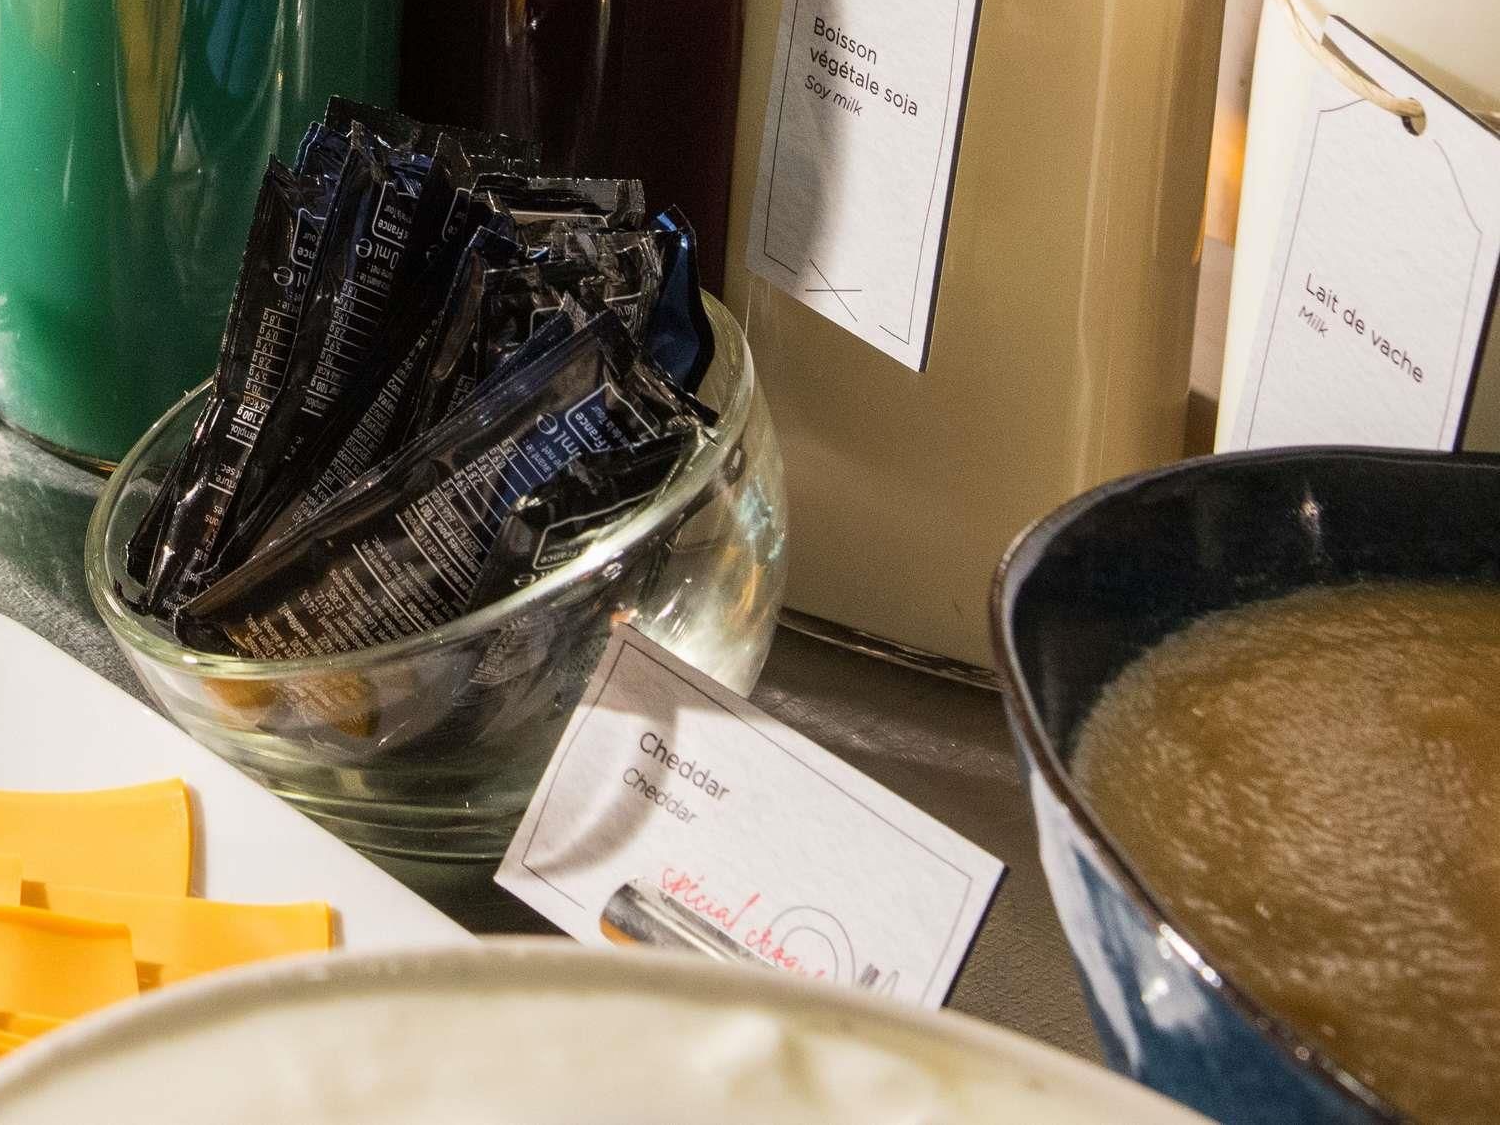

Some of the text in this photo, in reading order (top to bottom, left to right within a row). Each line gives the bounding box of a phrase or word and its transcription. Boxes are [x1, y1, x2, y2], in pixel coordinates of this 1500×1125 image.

[813, 17, 877, 65] Boisson
[804, 75, 863, 117] Soy milk
[810, 47, 918, 117] végétale soja
[377, 219, 403, 238] France
[265, 329, 278, 340] 0,9
[1298, 305, 1329, 339] Milk
[1305, 273, 1424, 383] Lait de vache
[258, 356, 271, 368] 2,8
[241, 395, 259, 409] kcal
[242, 410, 256, 422] 100
[230, 424, 257, 440] emploi.
[575, 412, 605, 447] France
[433, 520, 452, 538] pour
[639, 731, 730, 803] Cheddar
[622, 767, 698, 825] Cheddar
